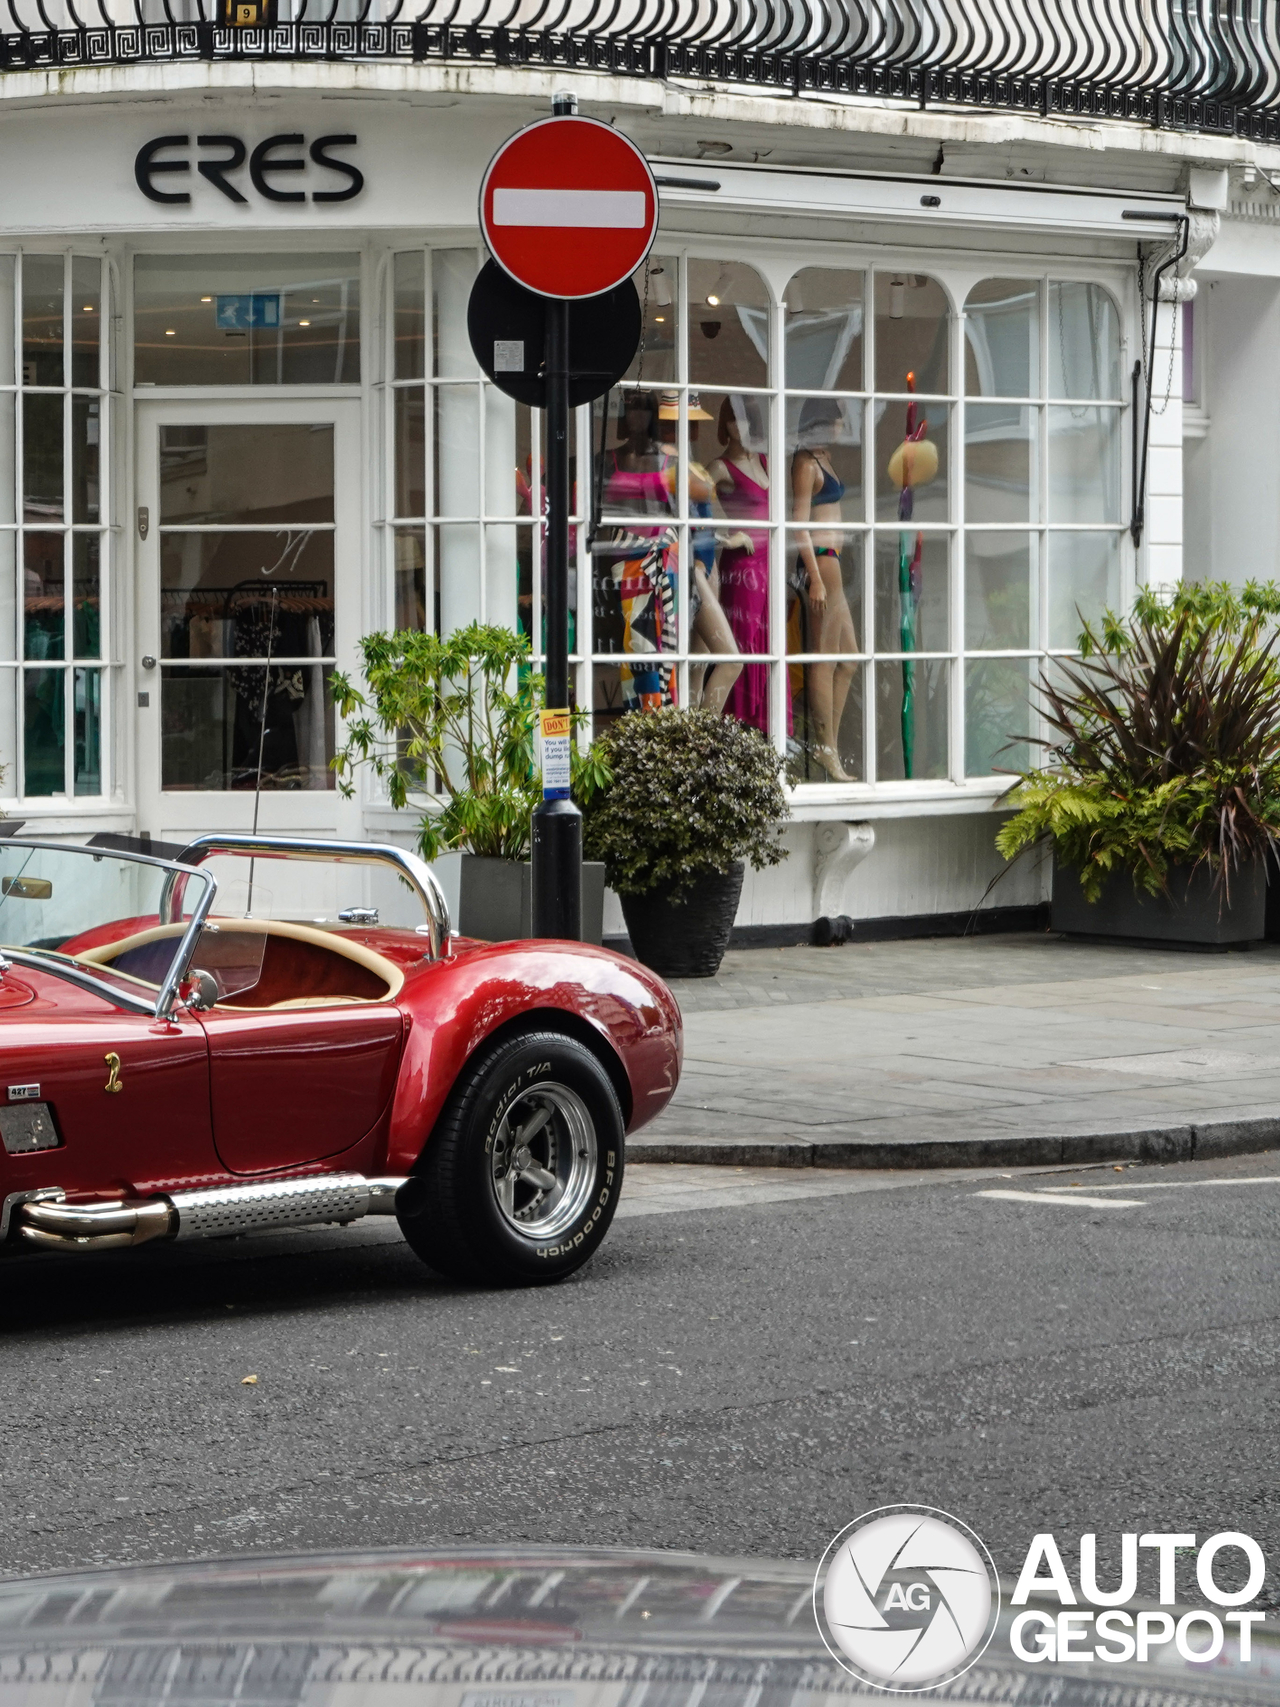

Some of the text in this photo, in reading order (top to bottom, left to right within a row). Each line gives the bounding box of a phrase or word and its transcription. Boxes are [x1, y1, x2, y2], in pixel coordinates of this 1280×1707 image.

[242, 8, 251, 19] 9
[134, 133, 364, 203] ERES
[11, 1087, 26, 1096] 427
[484, 1061, 552, 1155] Radial T/A
[536, 1150, 616, 1259] BFGoodrich
